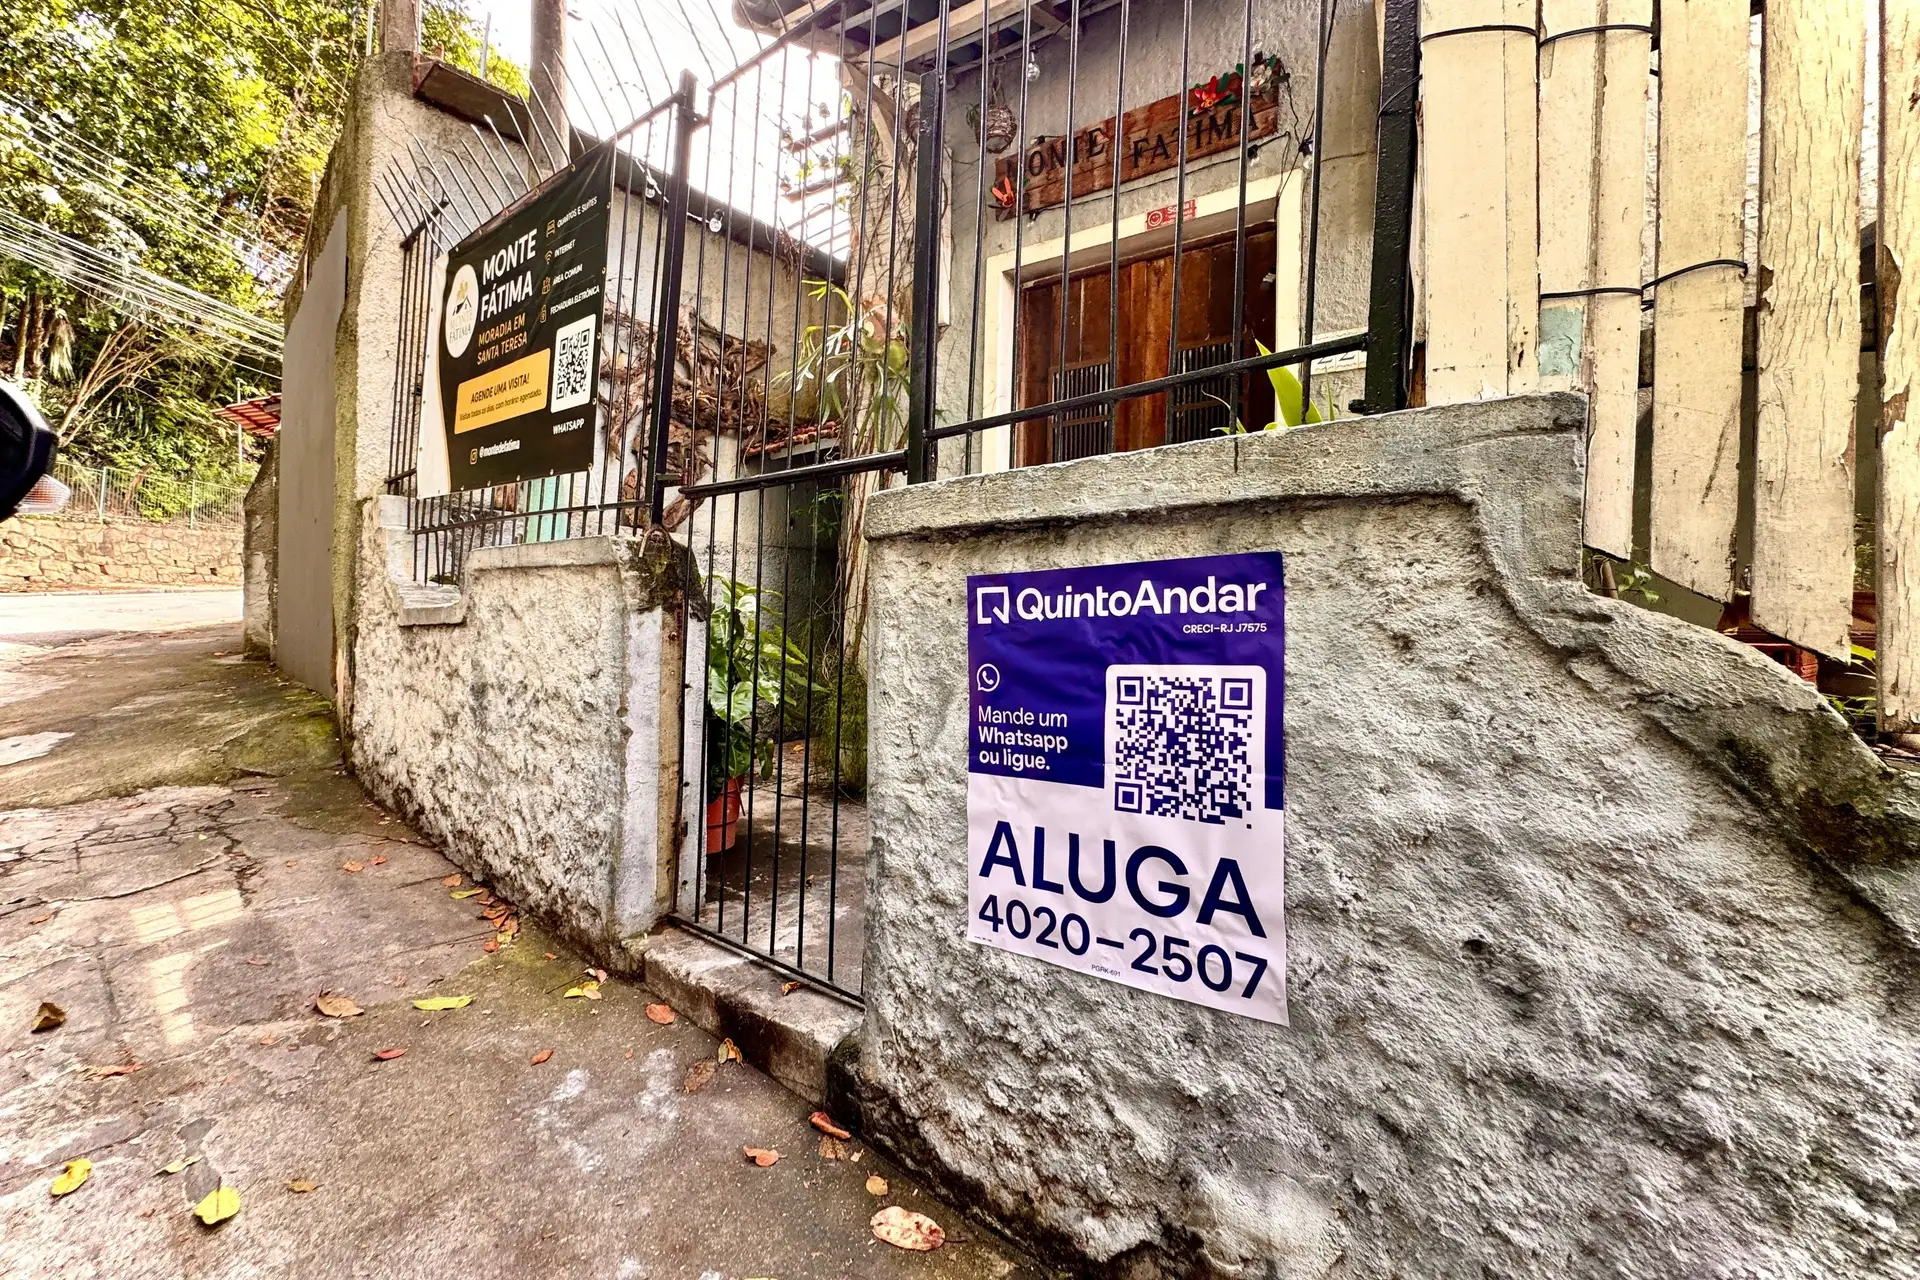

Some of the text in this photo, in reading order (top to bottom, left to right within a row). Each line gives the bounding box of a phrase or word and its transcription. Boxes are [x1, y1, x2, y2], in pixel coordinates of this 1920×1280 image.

[483, 228, 537, 285] MONTE
[554, 239, 576, 258] INTERNET
[564, 263, 583, 280] COMUM
[480, 270, 533, 322] FÁTIMA
[550, 297, 574, 316] FECHADURA
[478, 312, 526, 346] MORADIA EM
[477, 331, 528, 365] SANTA TERESA
[470, 372, 530, 405] AGENDE UMA VISITA!
[552, 418, 585, 435] WHATSAPP
[1016, 576, 1266, 622] QuintoAndar
[1182, 622, 1267, 634] CRECI-RJ J7575
[978, 705, 1068, 728] Mande um
[978, 725, 1068, 754] Whatsapp
[979, 748, 1050, 771] ou ligue.
[978, 820, 1268, 939] ALUGA
[978, 894, 1268, 999] 4020-2507
